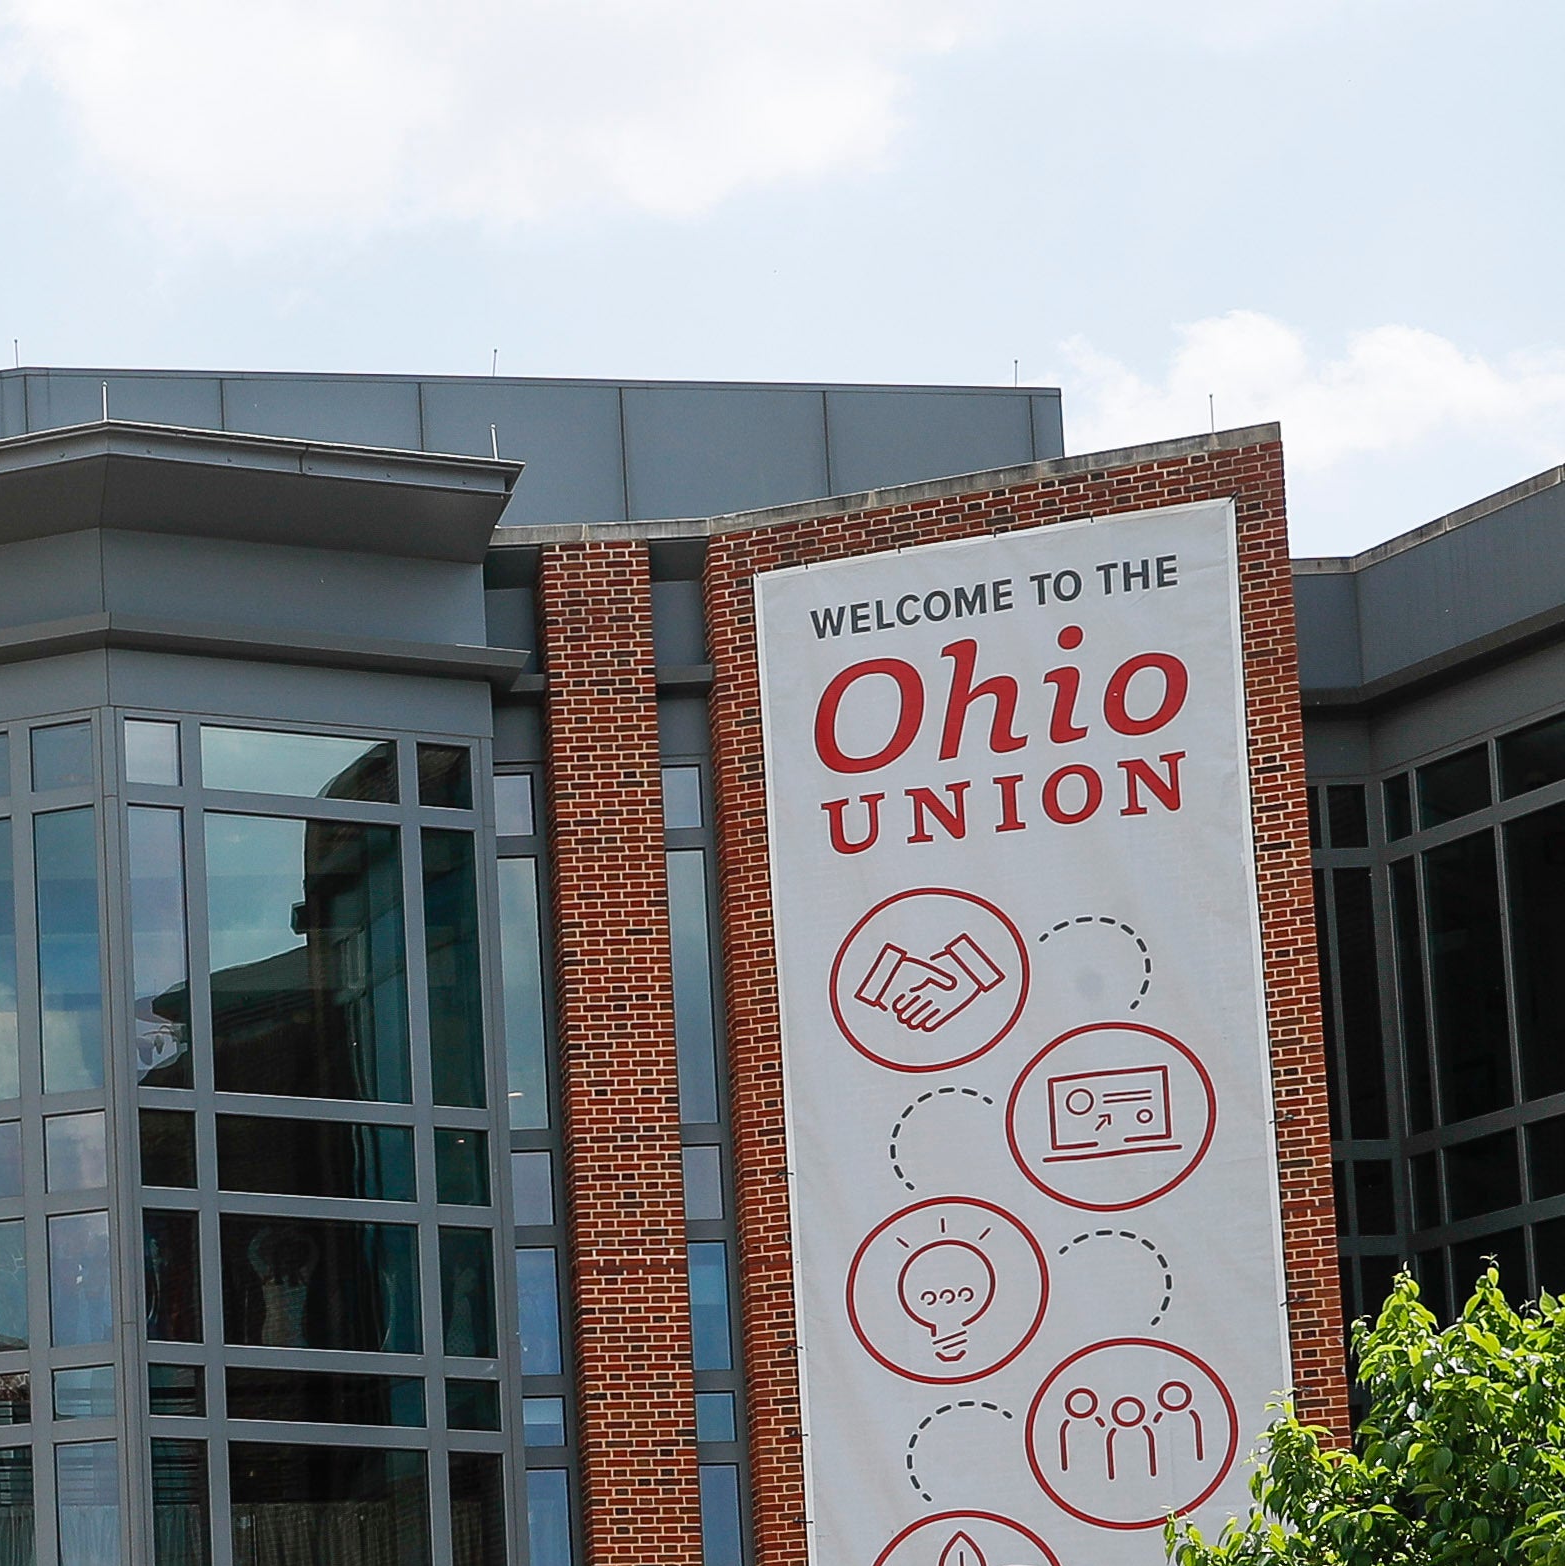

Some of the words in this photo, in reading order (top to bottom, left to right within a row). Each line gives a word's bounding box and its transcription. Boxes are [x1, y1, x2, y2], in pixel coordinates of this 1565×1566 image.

[810, 579, 1014, 640] WELCOME
[1030, 570, 1082, 605] TO
[1096, 555, 1178, 594] THE
[814, 625, 1188, 774] Ohio
[820, 750, 1186, 854] UNION
